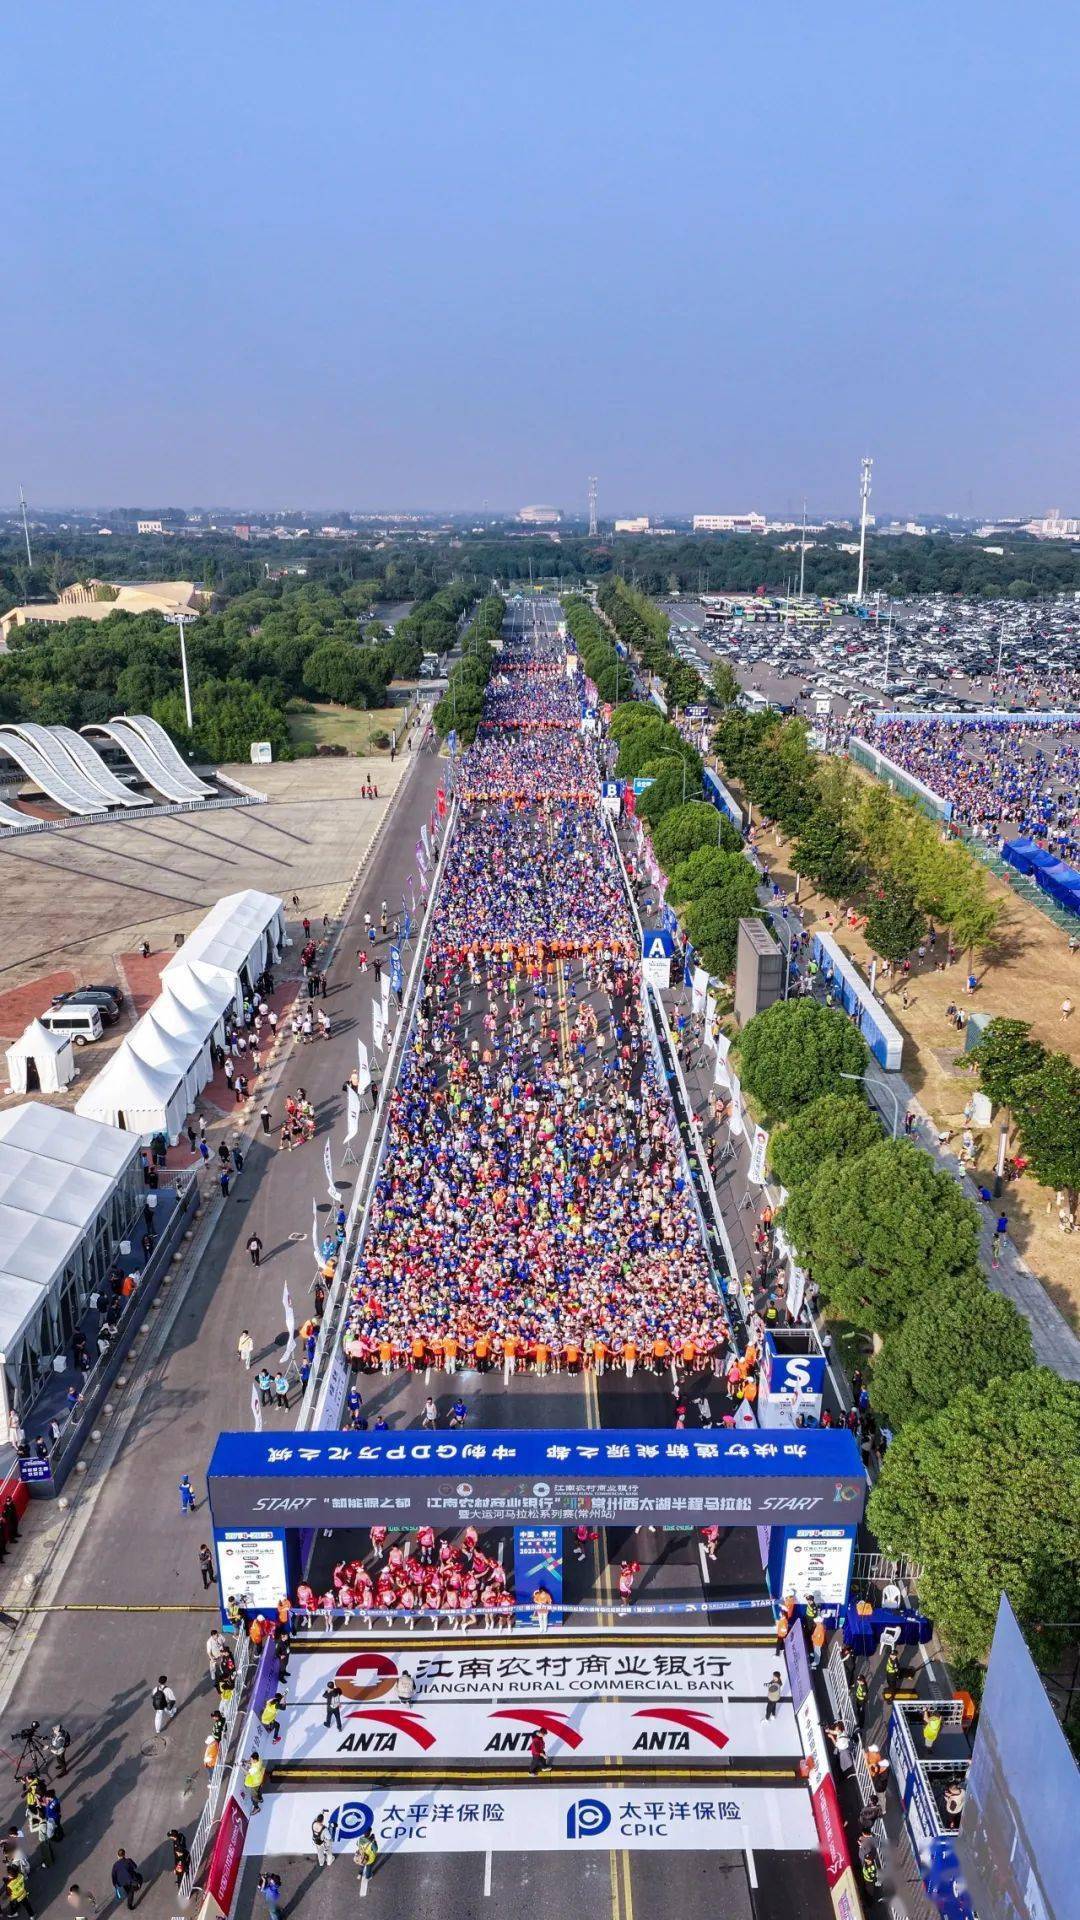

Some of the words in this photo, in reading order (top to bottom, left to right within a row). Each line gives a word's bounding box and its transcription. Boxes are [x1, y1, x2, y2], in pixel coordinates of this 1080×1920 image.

[607, 784, 617, 795] B
[649, 937, 666, 958] A
[784, 1358, 810, 1388] S
[252, 1497, 316, 1511] START
[758, 1497, 824, 1511] START
[751, 1599, 775, 1608] START
[415, 1654, 732, 1678] 江南农村商业银行
[416, 1682, 504, 1694] JIANGNAN
[509, 1682, 565, 1692] RURAL
[569, 1680, 683, 1691] COMMERCIAL
[688, 1680, 735, 1691] BANK
[336, 1733, 397, 1752] ANTA
[484, 1732, 533, 1751] ANT
[632, 1731, 690, 1750] ANTA
[382, 1803, 505, 1823] 太平洋保险
[619, 1801, 742, 1821] 太平洋保险
[380, 1826, 427, 1839] CPIC
[620, 1823, 668, 1837] CPIC
